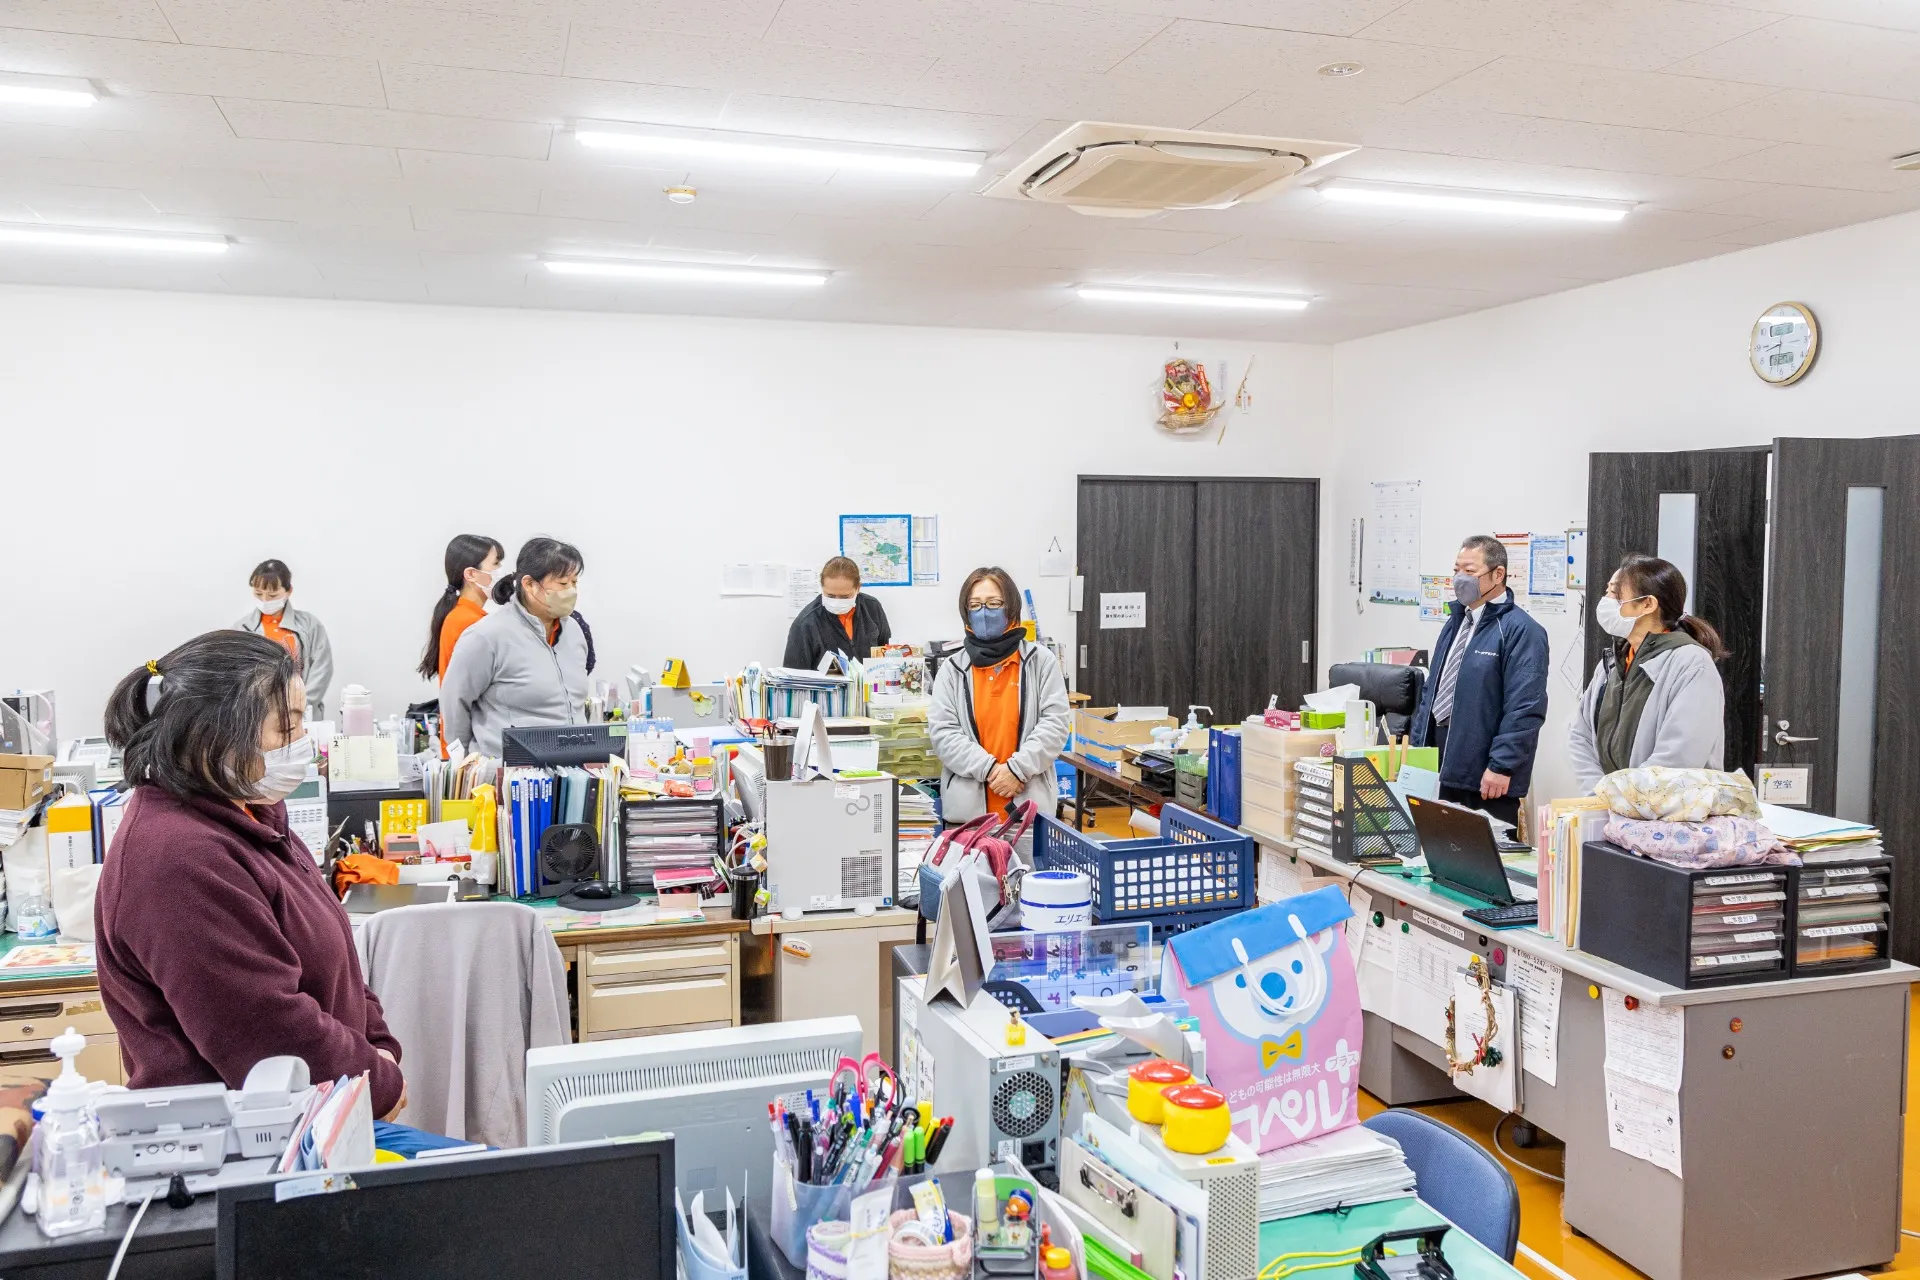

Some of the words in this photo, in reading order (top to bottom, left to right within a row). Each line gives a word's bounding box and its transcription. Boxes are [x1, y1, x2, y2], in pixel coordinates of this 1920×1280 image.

[1328, 1052, 1357, 1070] プラス
[1224, 1062, 1321, 1104] どもの可能性は無限大
